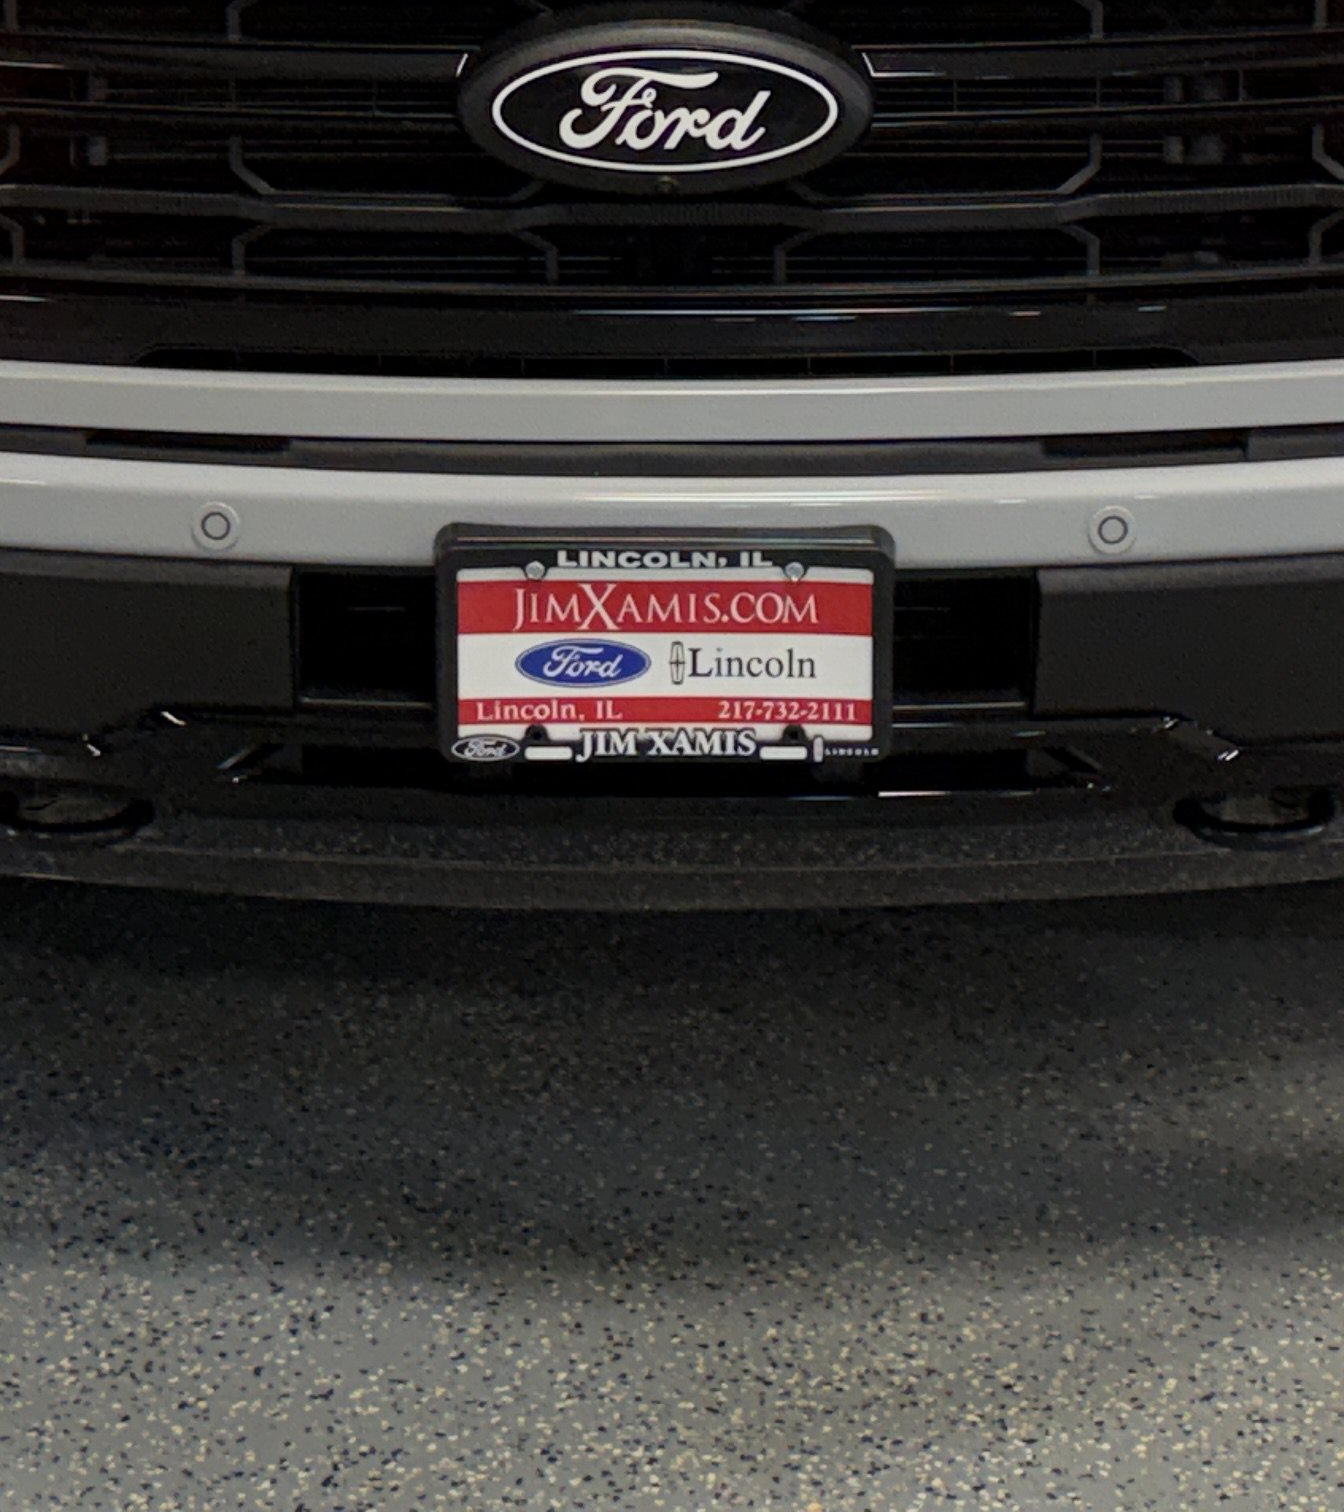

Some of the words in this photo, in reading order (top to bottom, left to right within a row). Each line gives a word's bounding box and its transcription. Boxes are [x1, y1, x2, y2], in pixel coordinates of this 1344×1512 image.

[559, 67, 771, 150] Ford
[557, 550, 728, 569] LINCOLN,
[740, 549, 773, 568] IL
[513, 583, 819, 631] JIMXAMIS.COM
[543, 645, 623, 679] Ford
[689, 647, 817, 679] Lincoln
[595, 702, 623, 721] IL
[718, 701, 857, 722] 217-732-2111
[464, 738, 508, 758] Ford
[576, 727, 640, 762] JIM
[645, 728, 757, 757] XAMIS
